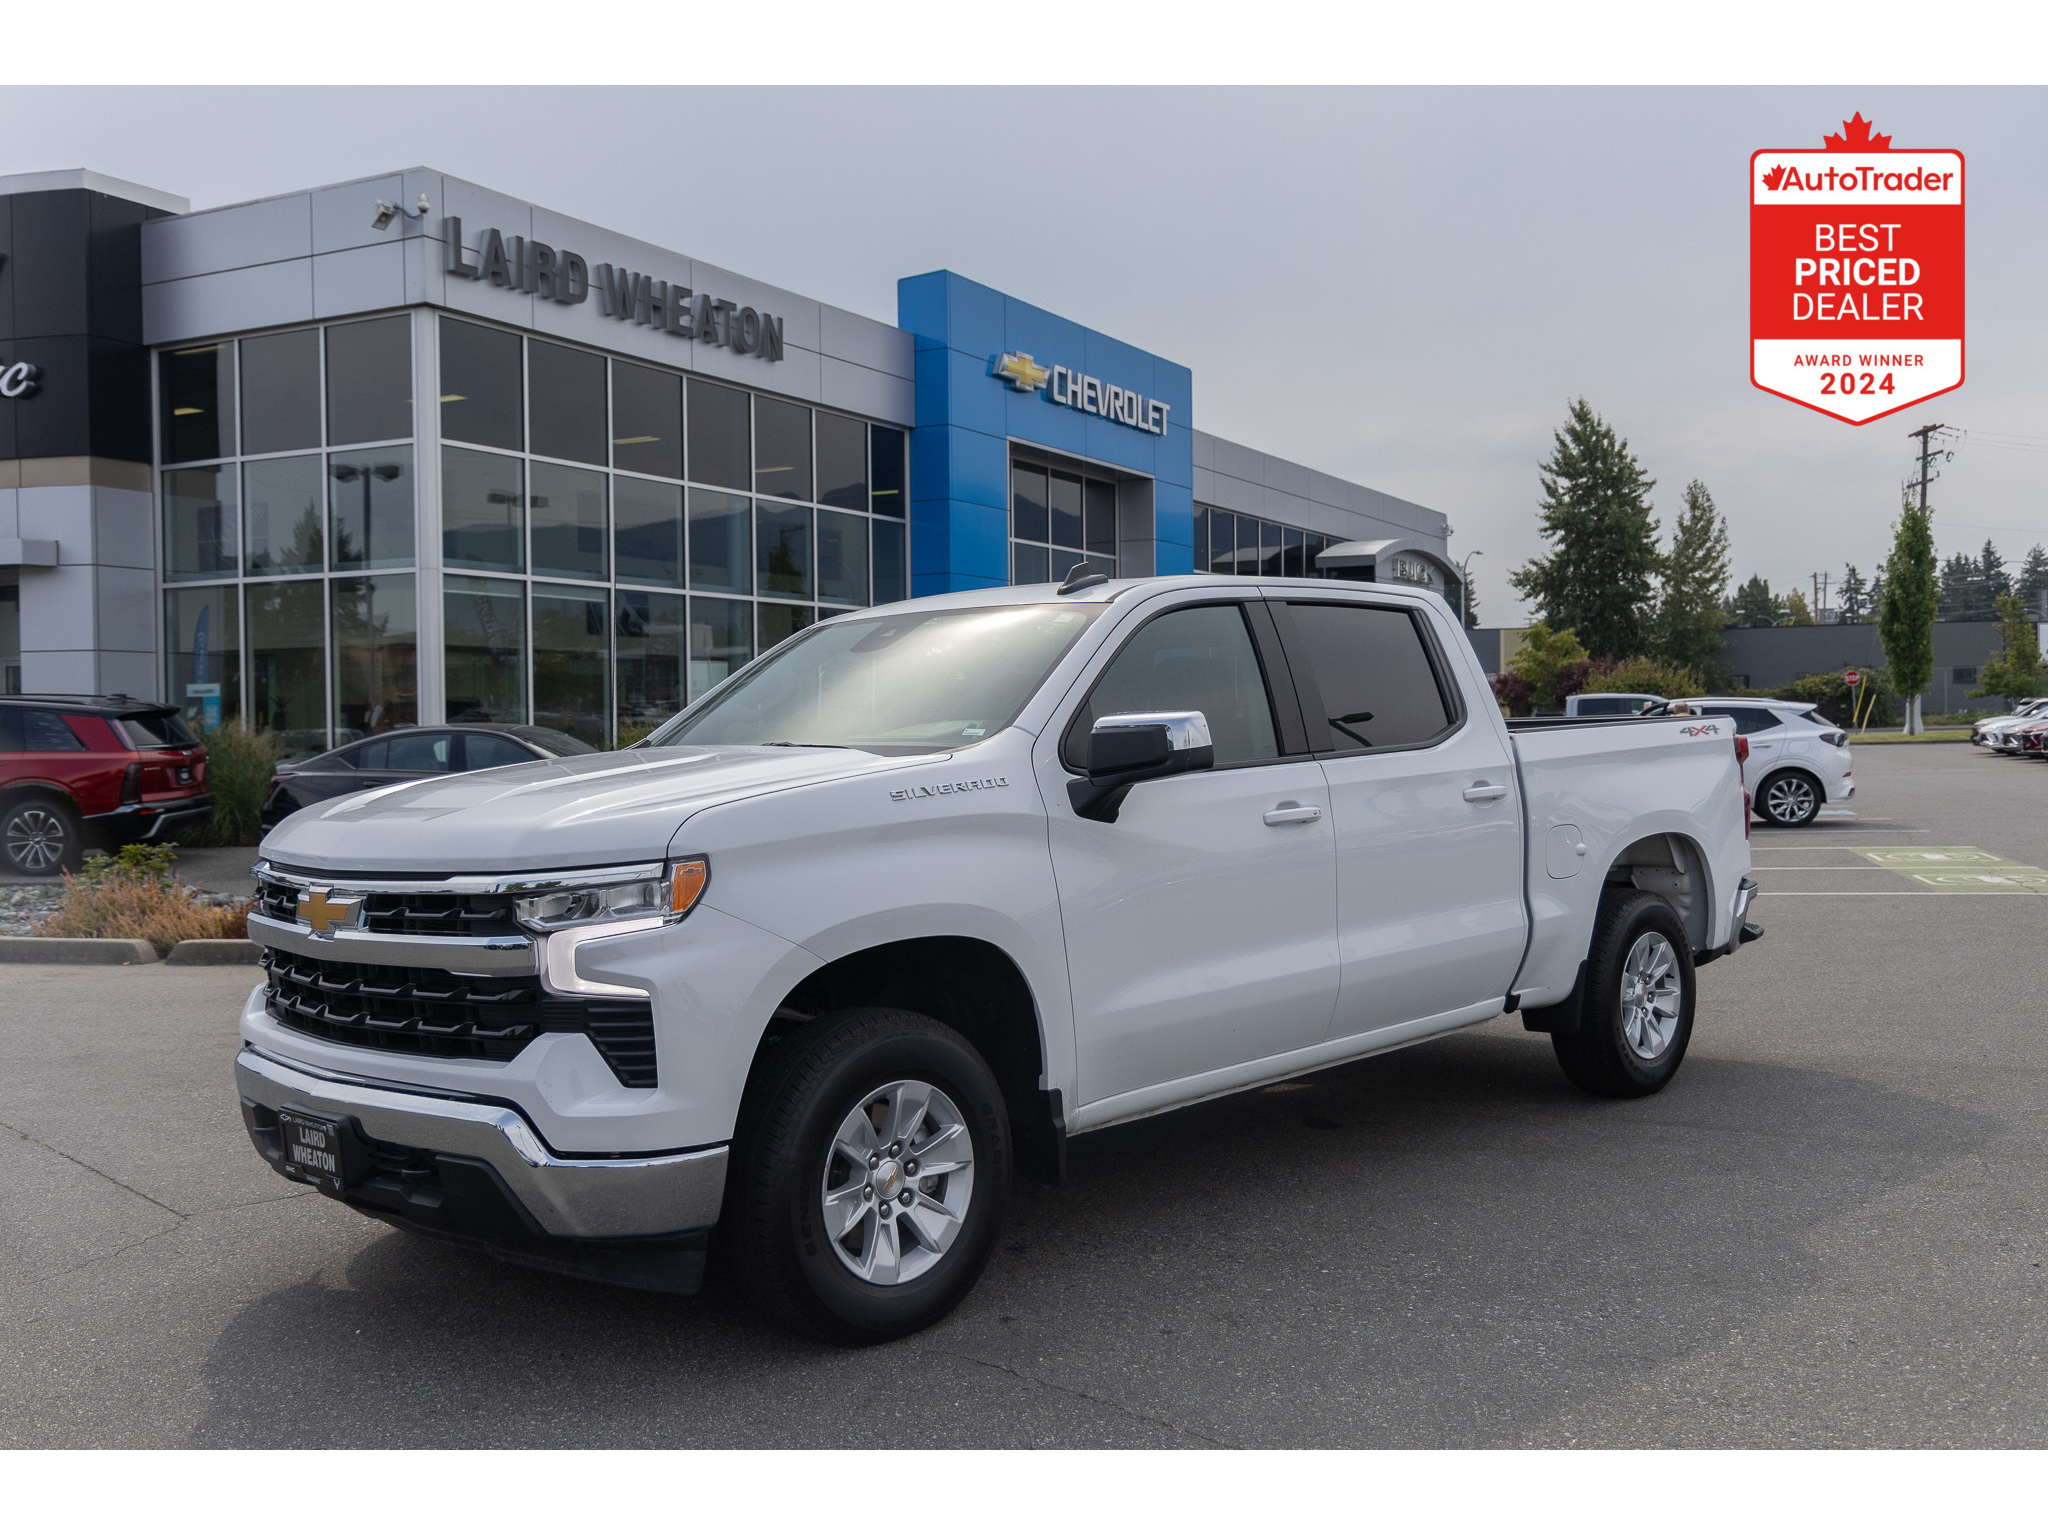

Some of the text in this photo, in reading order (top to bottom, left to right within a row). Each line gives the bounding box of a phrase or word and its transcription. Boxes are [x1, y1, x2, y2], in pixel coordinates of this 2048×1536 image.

[443, 215, 785, 362] LAIRD WHEATON
[1051, 364, 1171, 436] CHEVROLET
[889, 776, 1010, 802] SILVERADO
[299, 1126, 326, 1149] LAIRD
[292, 1143, 336, 1173] WHEATON
